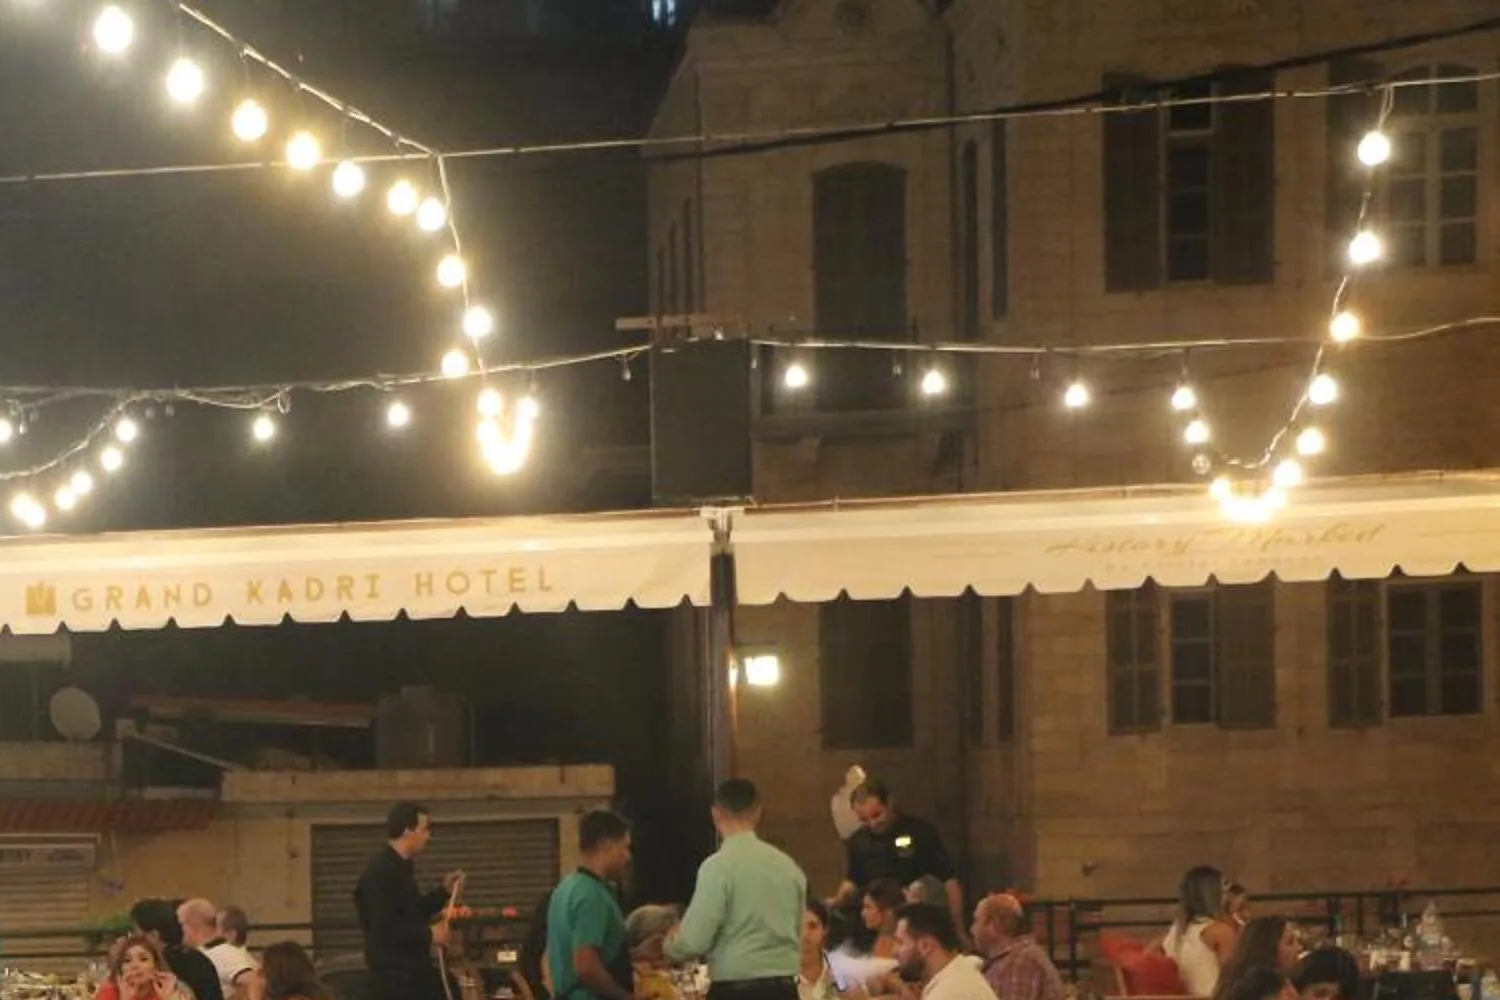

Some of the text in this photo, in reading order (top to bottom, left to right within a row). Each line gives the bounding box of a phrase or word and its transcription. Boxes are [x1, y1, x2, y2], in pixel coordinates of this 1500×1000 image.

[71, 566, 553, 612] GRAND KADRI HOTEL
